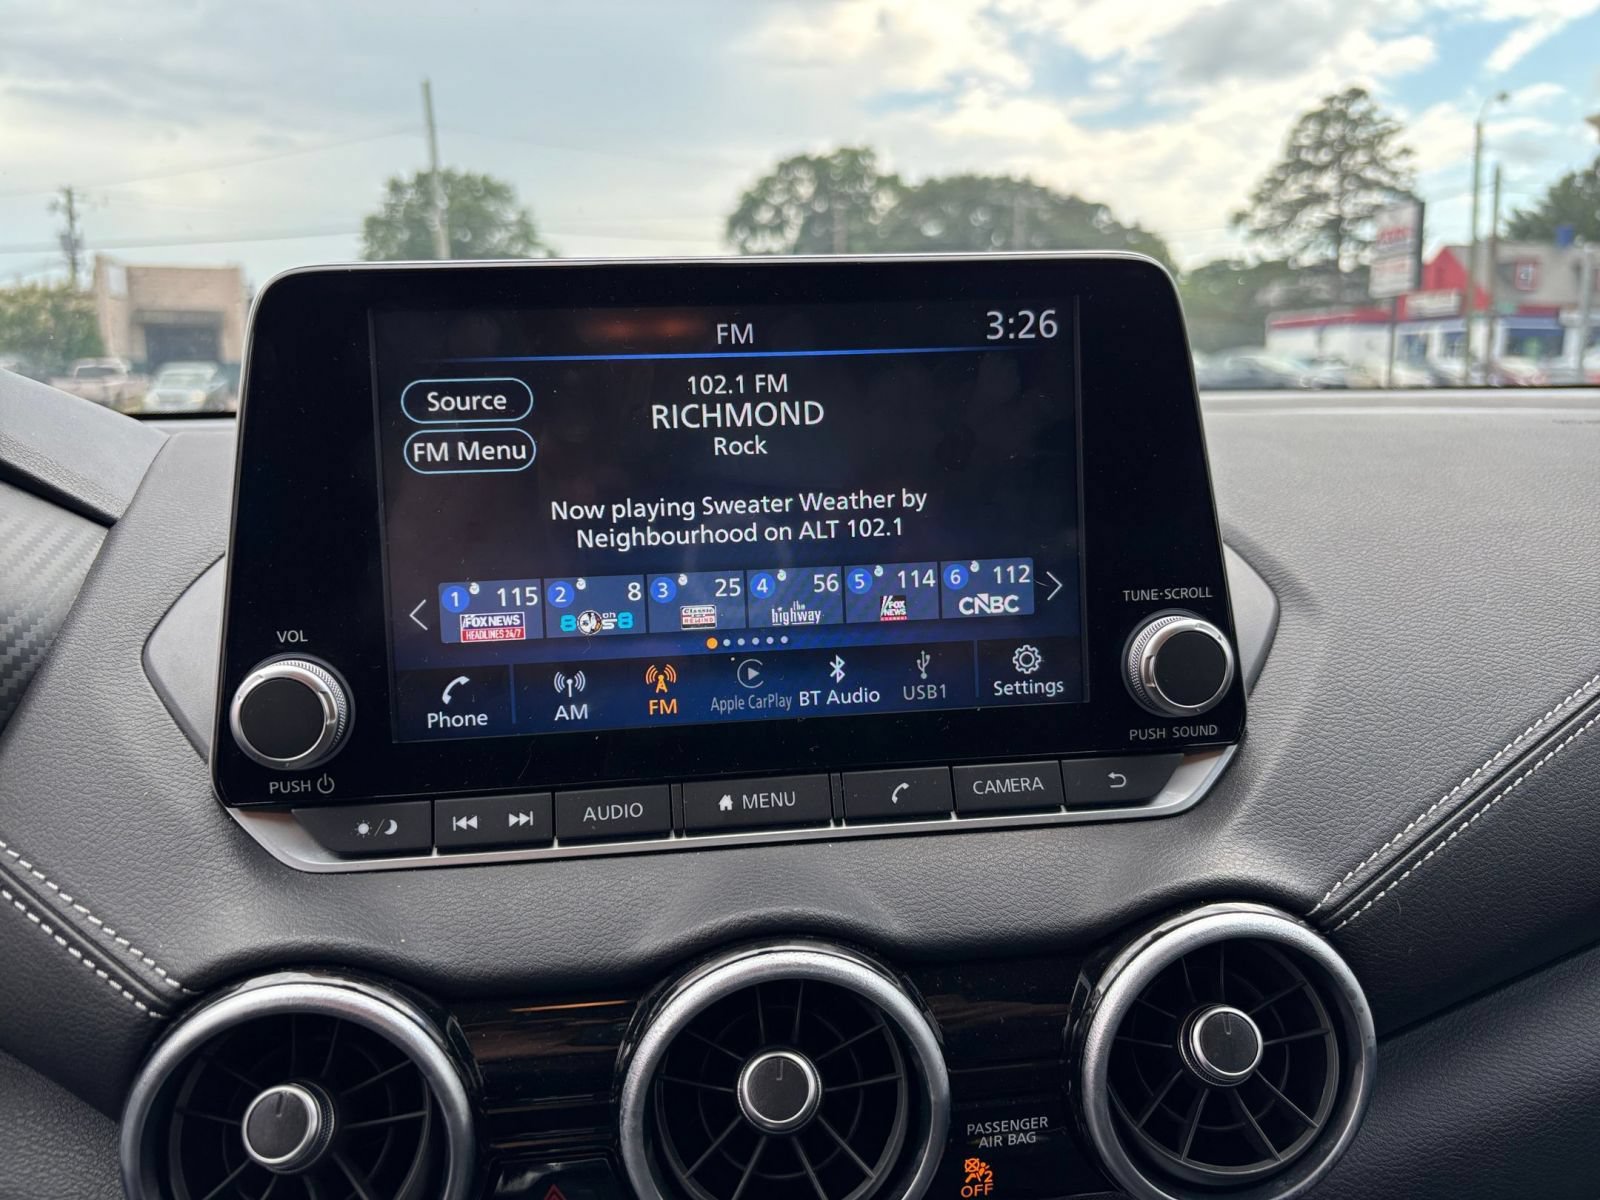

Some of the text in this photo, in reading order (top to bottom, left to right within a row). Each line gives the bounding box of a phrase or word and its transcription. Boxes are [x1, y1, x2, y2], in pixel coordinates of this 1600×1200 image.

[716, 323, 754, 345] FM
[986, 309, 1058, 340] 3:26
[687, 373, 788, 395] 102.1 FM
[426, 391, 507, 412] Source
[651, 400, 825, 430] RICHMOND
[413, 441, 527, 462] FM Menu
[713, 434, 768, 456] Rock
[551, 487, 928, 523] Now playing Sweater Weather by
[577, 517, 903, 552] Neighbourhood on ALT 102.1
[813, 574, 840, 593] 56
[854, 573, 866, 589] 5
[898, 569, 936, 589] 114
[950, 569, 961, 585] 6
[993, 564, 1031, 584] 112
[554, 587, 568, 603] 2
[627, 582, 642, 602] 8
[657, 582, 669, 598] 3
[714, 578, 741, 598] 25
[756, 578, 769, 594] 4
[450, 591, 460, 608] 1
[497, 586, 539, 607] 115
[958, 593, 1020, 615] CNBC
[463, 614, 521, 629] FOX NEWS
[771, 607, 822, 625] highway
[276, 630, 308, 643] VOL
[465, 628, 504, 640] HEADLINES
[799, 687, 880, 706] BT Audio
[903, 683, 946, 700] USB1
[993, 679, 1064, 697] Settings
[554, 703, 589, 721] AM
[649, 698, 678, 715] FM
[710, 694, 793, 714] Apple CarPlay
[427, 711, 489, 729] Phone
[1129, 724, 1218, 741] PUSH SOUND
[269, 779, 312, 794] PUSH
[972, 776, 1045, 796] CAMERA
[742, 791, 796, 810] MENU
[583, 802, 644, 822] AUDIO
[966, 1116, 1049, 1136] PASSENGER
[978, 1131, 1037, 1149] AIR BAG
[960, 1182, 994, 1198] OFF
